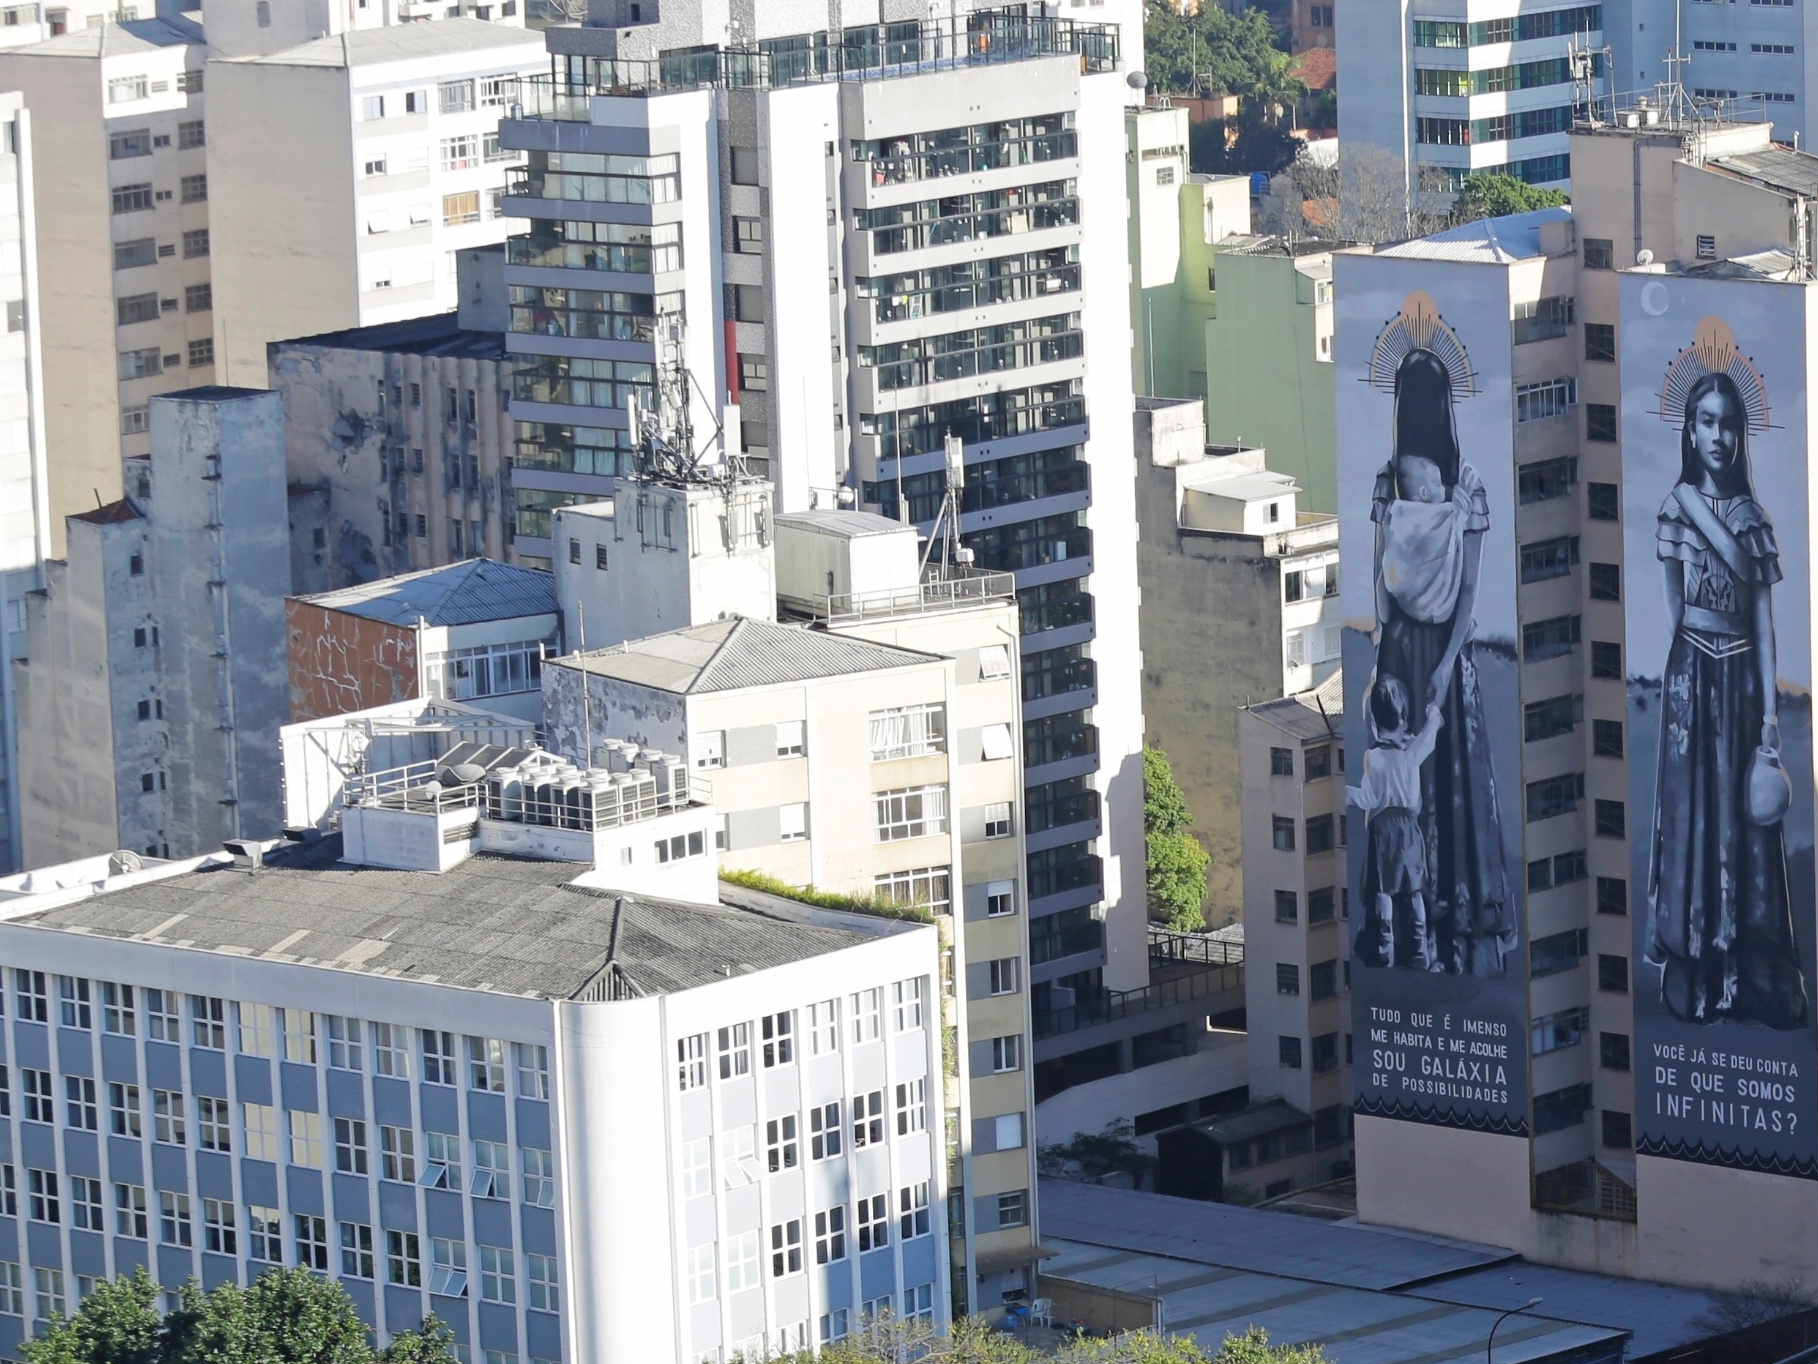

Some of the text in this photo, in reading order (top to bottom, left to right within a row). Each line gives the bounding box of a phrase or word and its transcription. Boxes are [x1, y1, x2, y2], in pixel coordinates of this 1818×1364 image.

[1371, 1006, 1507, 1037] TUDO QUE É IMENSO
[1371, 1028, 1508, 1059] ME HABITA E ME ACOLHE
[1653, 1043, 1799, 1078] VOCÊ JÁ SE DEU CONTA
[1372, 1049, 1508, 1086] SOU GALÁXIA
[1655, 1066, 1795, 1103] DE QUE SOMOS
[1372, 1072, 1508, 1104] DE POSSIBILIDADES
[1656, 1091, 1797, 1135] INFINITAS?
